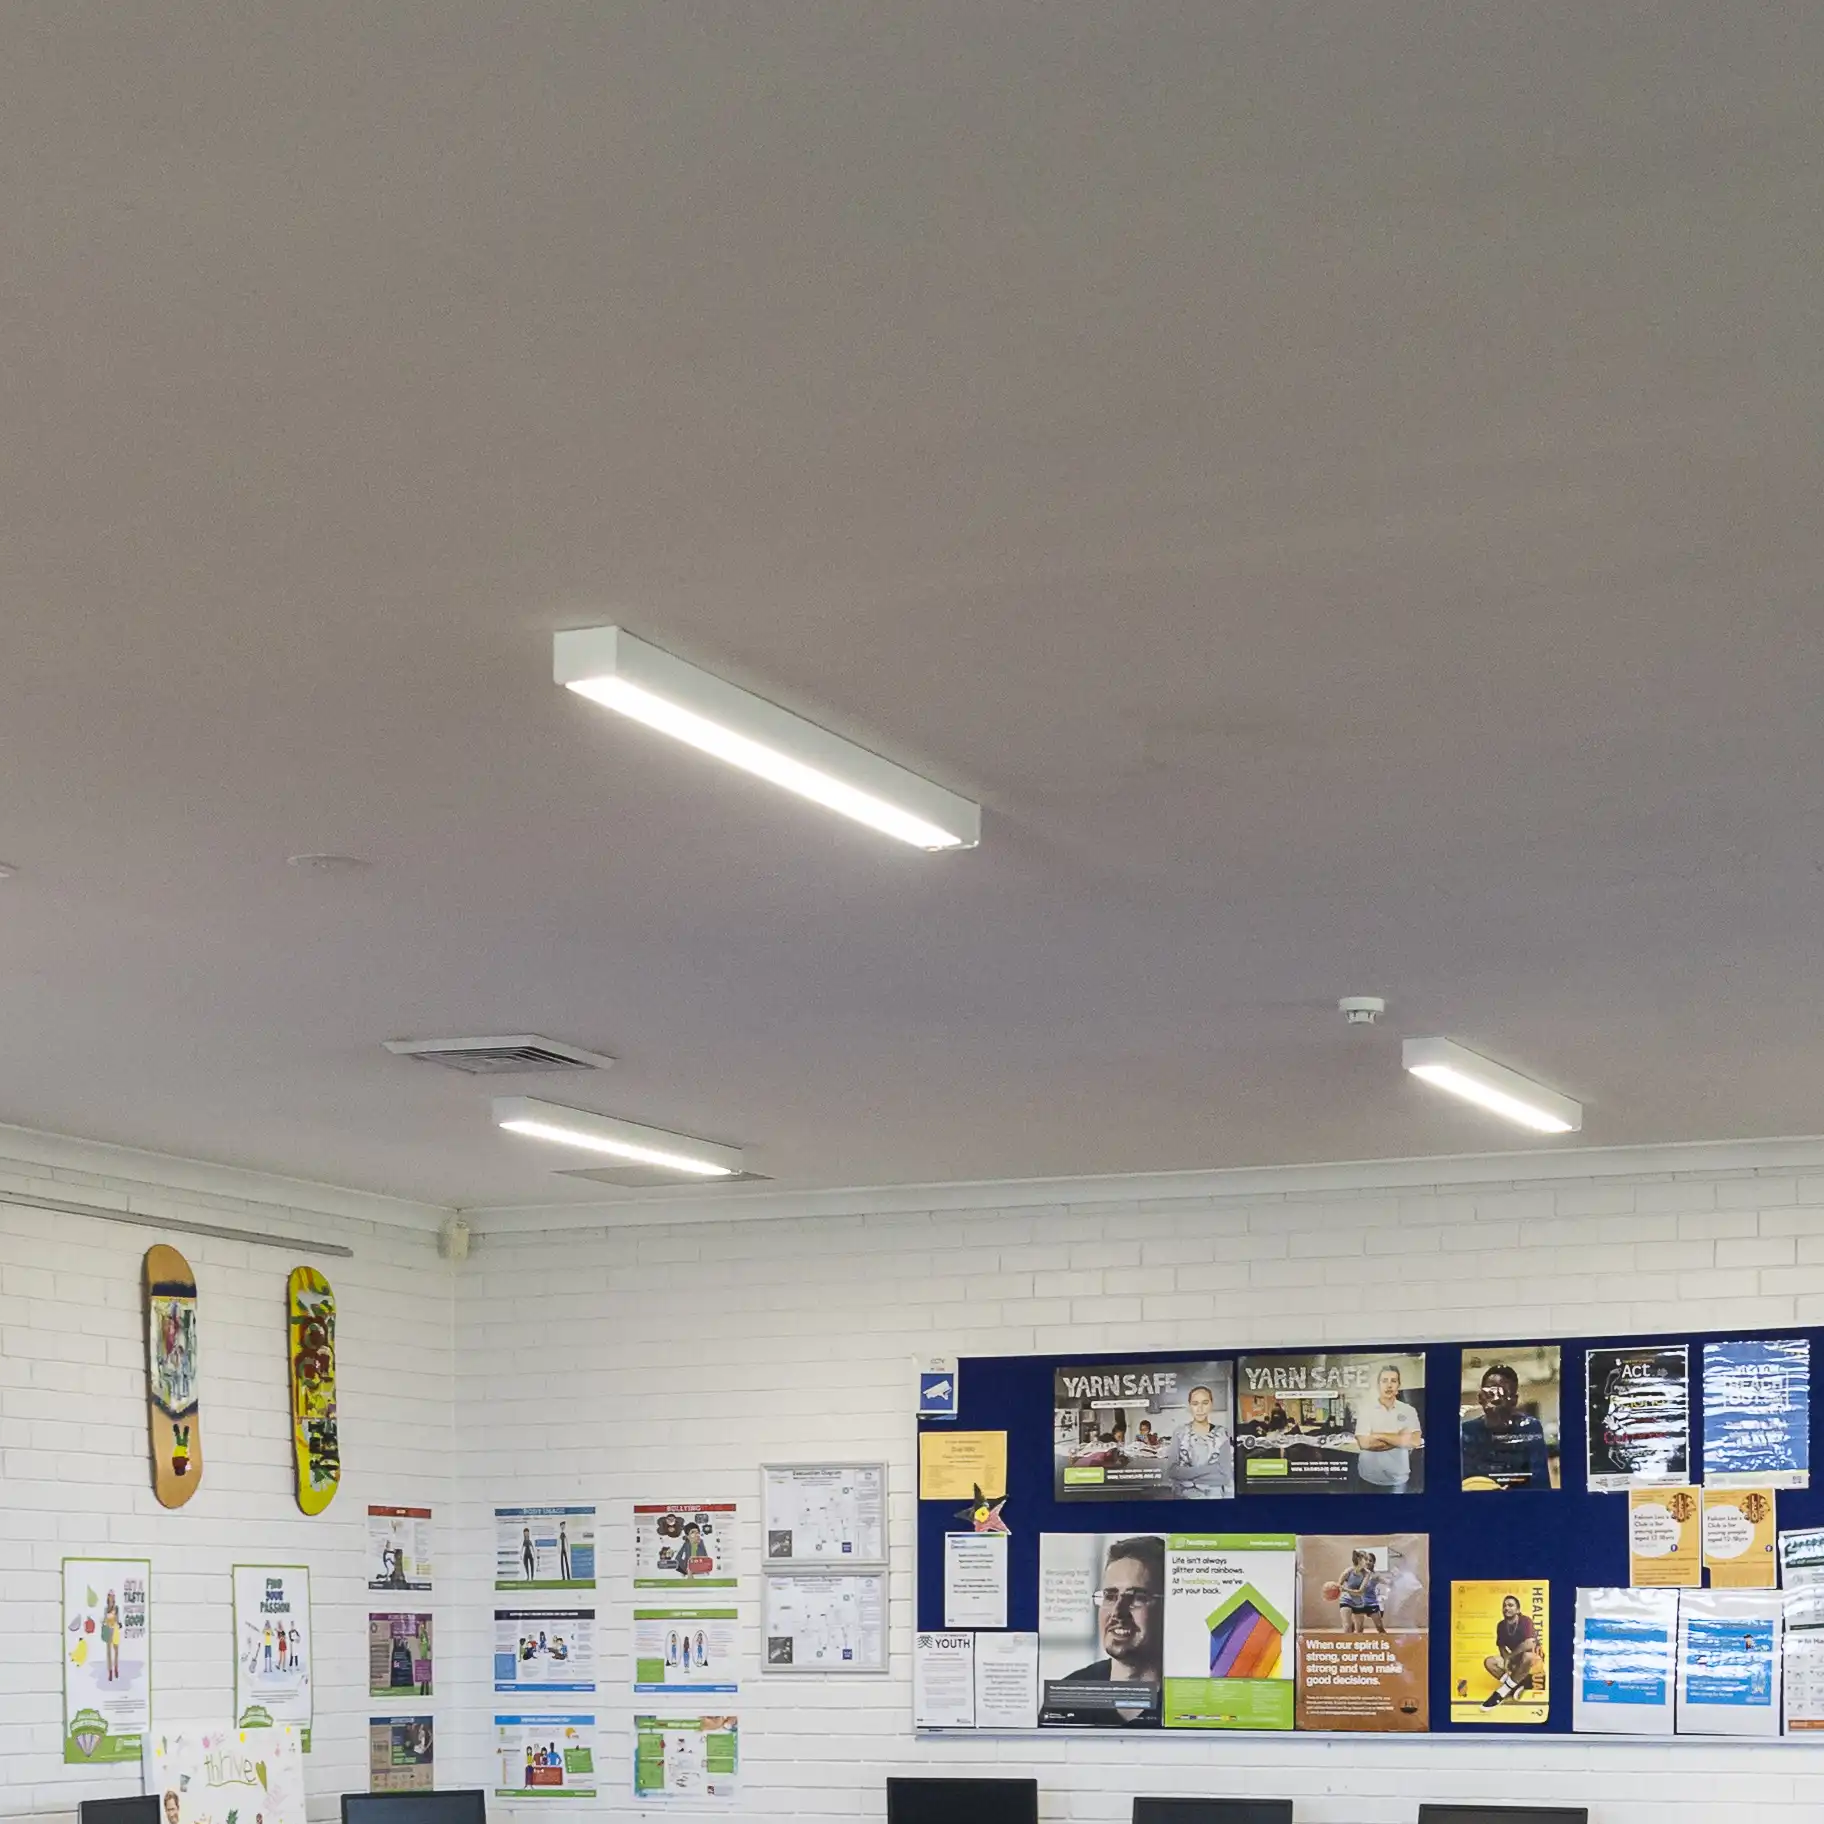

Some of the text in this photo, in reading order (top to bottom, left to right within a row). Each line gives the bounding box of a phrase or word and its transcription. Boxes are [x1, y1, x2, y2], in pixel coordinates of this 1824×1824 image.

[1621, 1363, 1652, 1379] Act
[1244, 1364, 1371, 1391] YARN SAFE
[1063, 1372, 1179, 1399] YARN SAFE
[821, 1469, 843, 1477] Diagram
[543, 1507, 566, 1515] IMAGE
[665, 1504, 702, 1513] BULLYING
[1172, 1557, 1227, 1566] Life isn't always
[1172, 1566, 1245, 1575] glitter and rainbows.
[266, 1578, 283, 1590] FIND
[1172, 1577, 1181, 1585] At
[1171, 1587, 1184, 1595] got
[1202, 1587, 1222, 1595] back.
[260, 1600, 290, 1614] PASSION
[935, 1638, 971, 1649] YOUTH
[1306, 1640, 1390, 1652] When our spirit is
[1306, 1652, 1396, 1664] strong, our mind is
[1306, 1664, 1404, 1675] strong and we make
[1306, 1675, 1381, 1687] good decisions.
[204, 1750, 257, 1784] thrive
